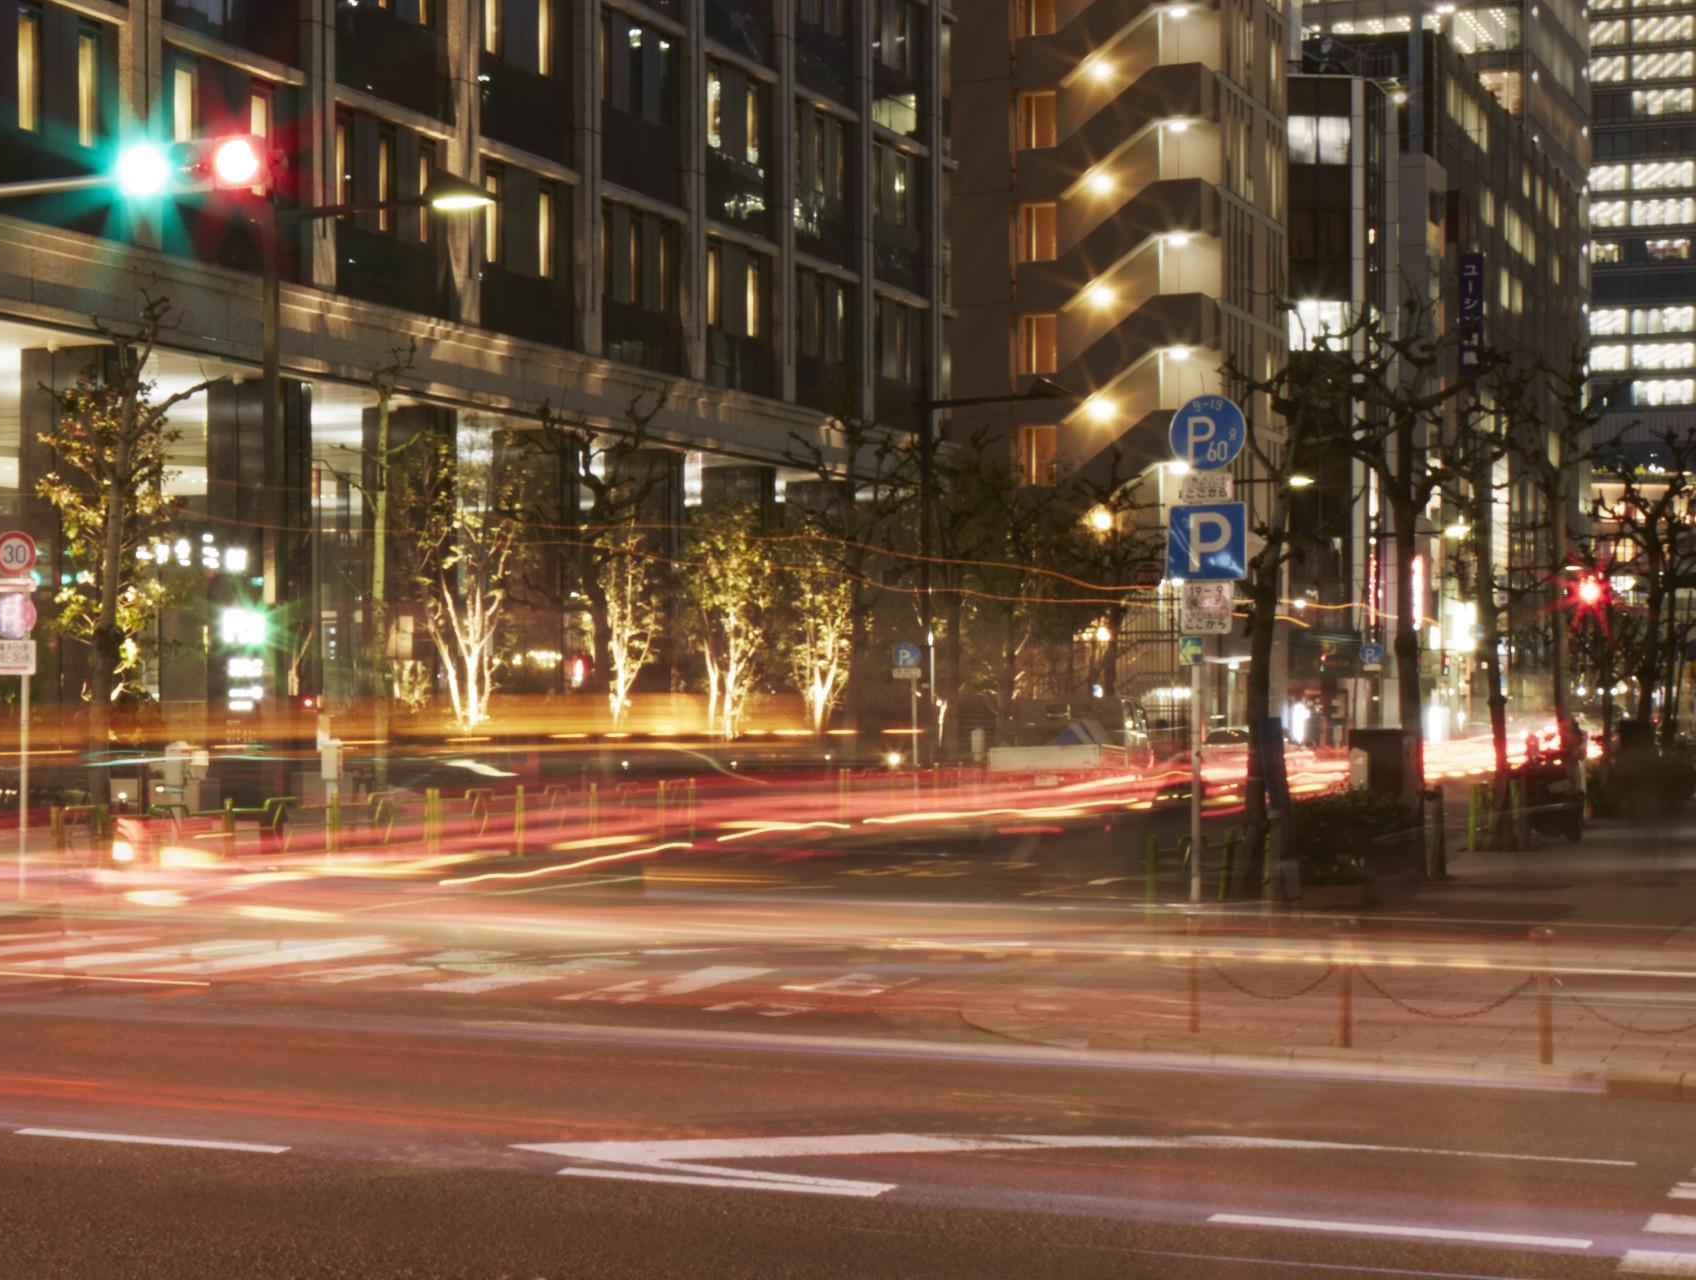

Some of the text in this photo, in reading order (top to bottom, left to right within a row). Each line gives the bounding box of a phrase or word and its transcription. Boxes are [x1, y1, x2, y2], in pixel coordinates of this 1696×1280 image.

[1187, 416, 1216, 465] P
[1207, 440, 1229, 462] 60
[3, 544, 27, 564] 30
[1189, 512, 1232, 573] P
